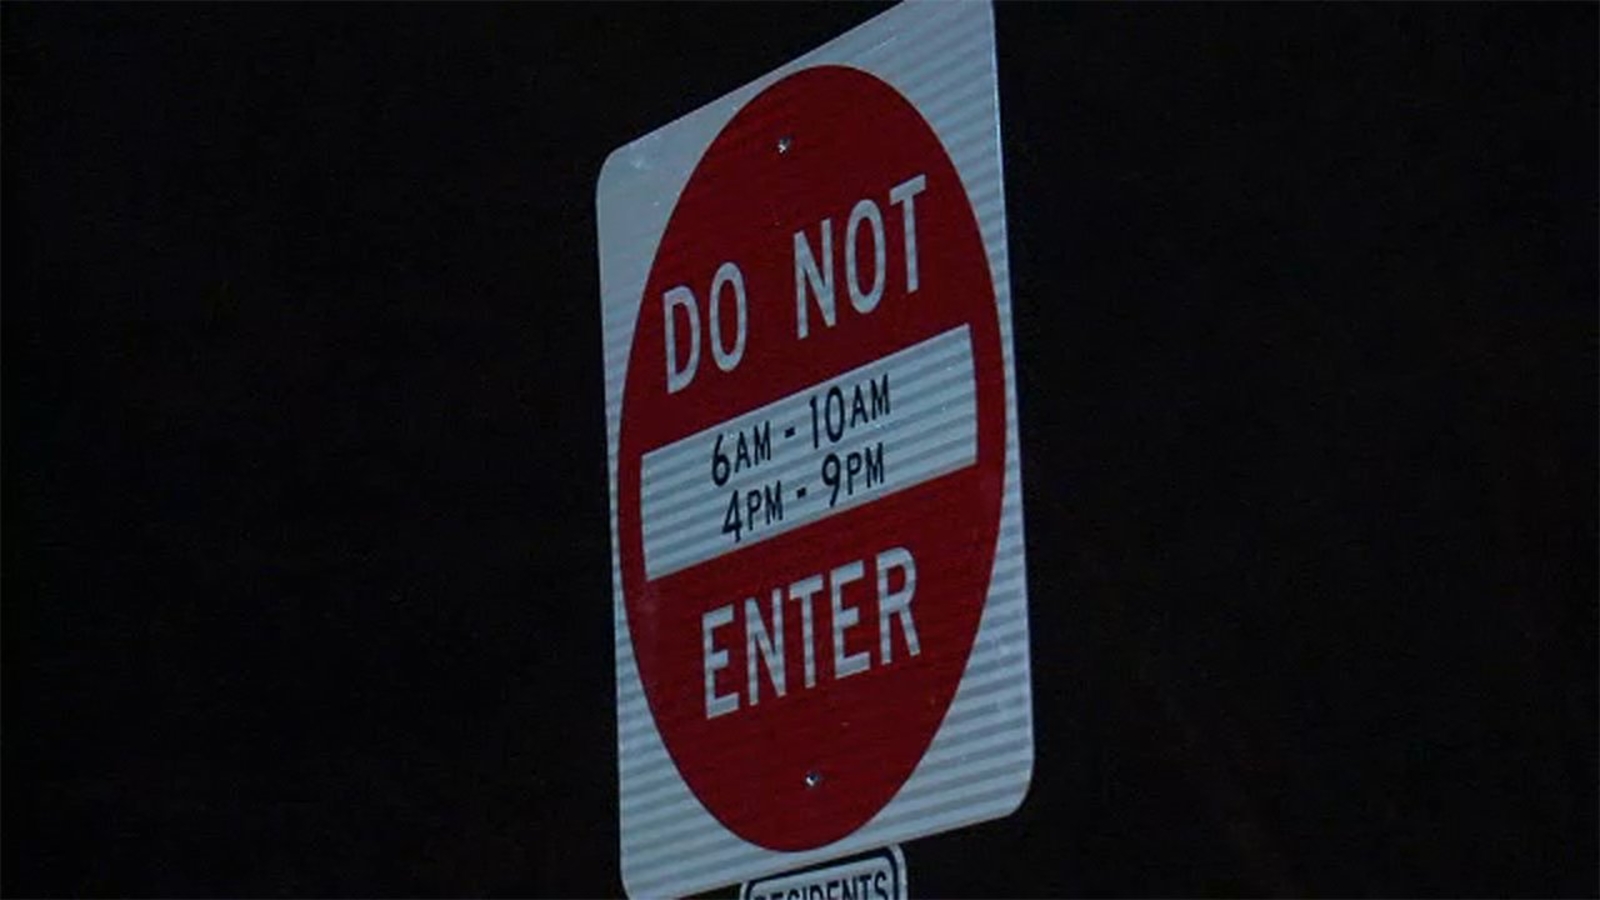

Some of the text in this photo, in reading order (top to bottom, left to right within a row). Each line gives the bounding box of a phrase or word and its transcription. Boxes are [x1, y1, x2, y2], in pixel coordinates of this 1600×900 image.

[663, 174, 927, 395] DO NOT
[711, 374, 891, 487] 6AM - 10AM
[722, 442, 885, 543] 4PM - 9PM
[701, 546, 922, 719] ENTER
